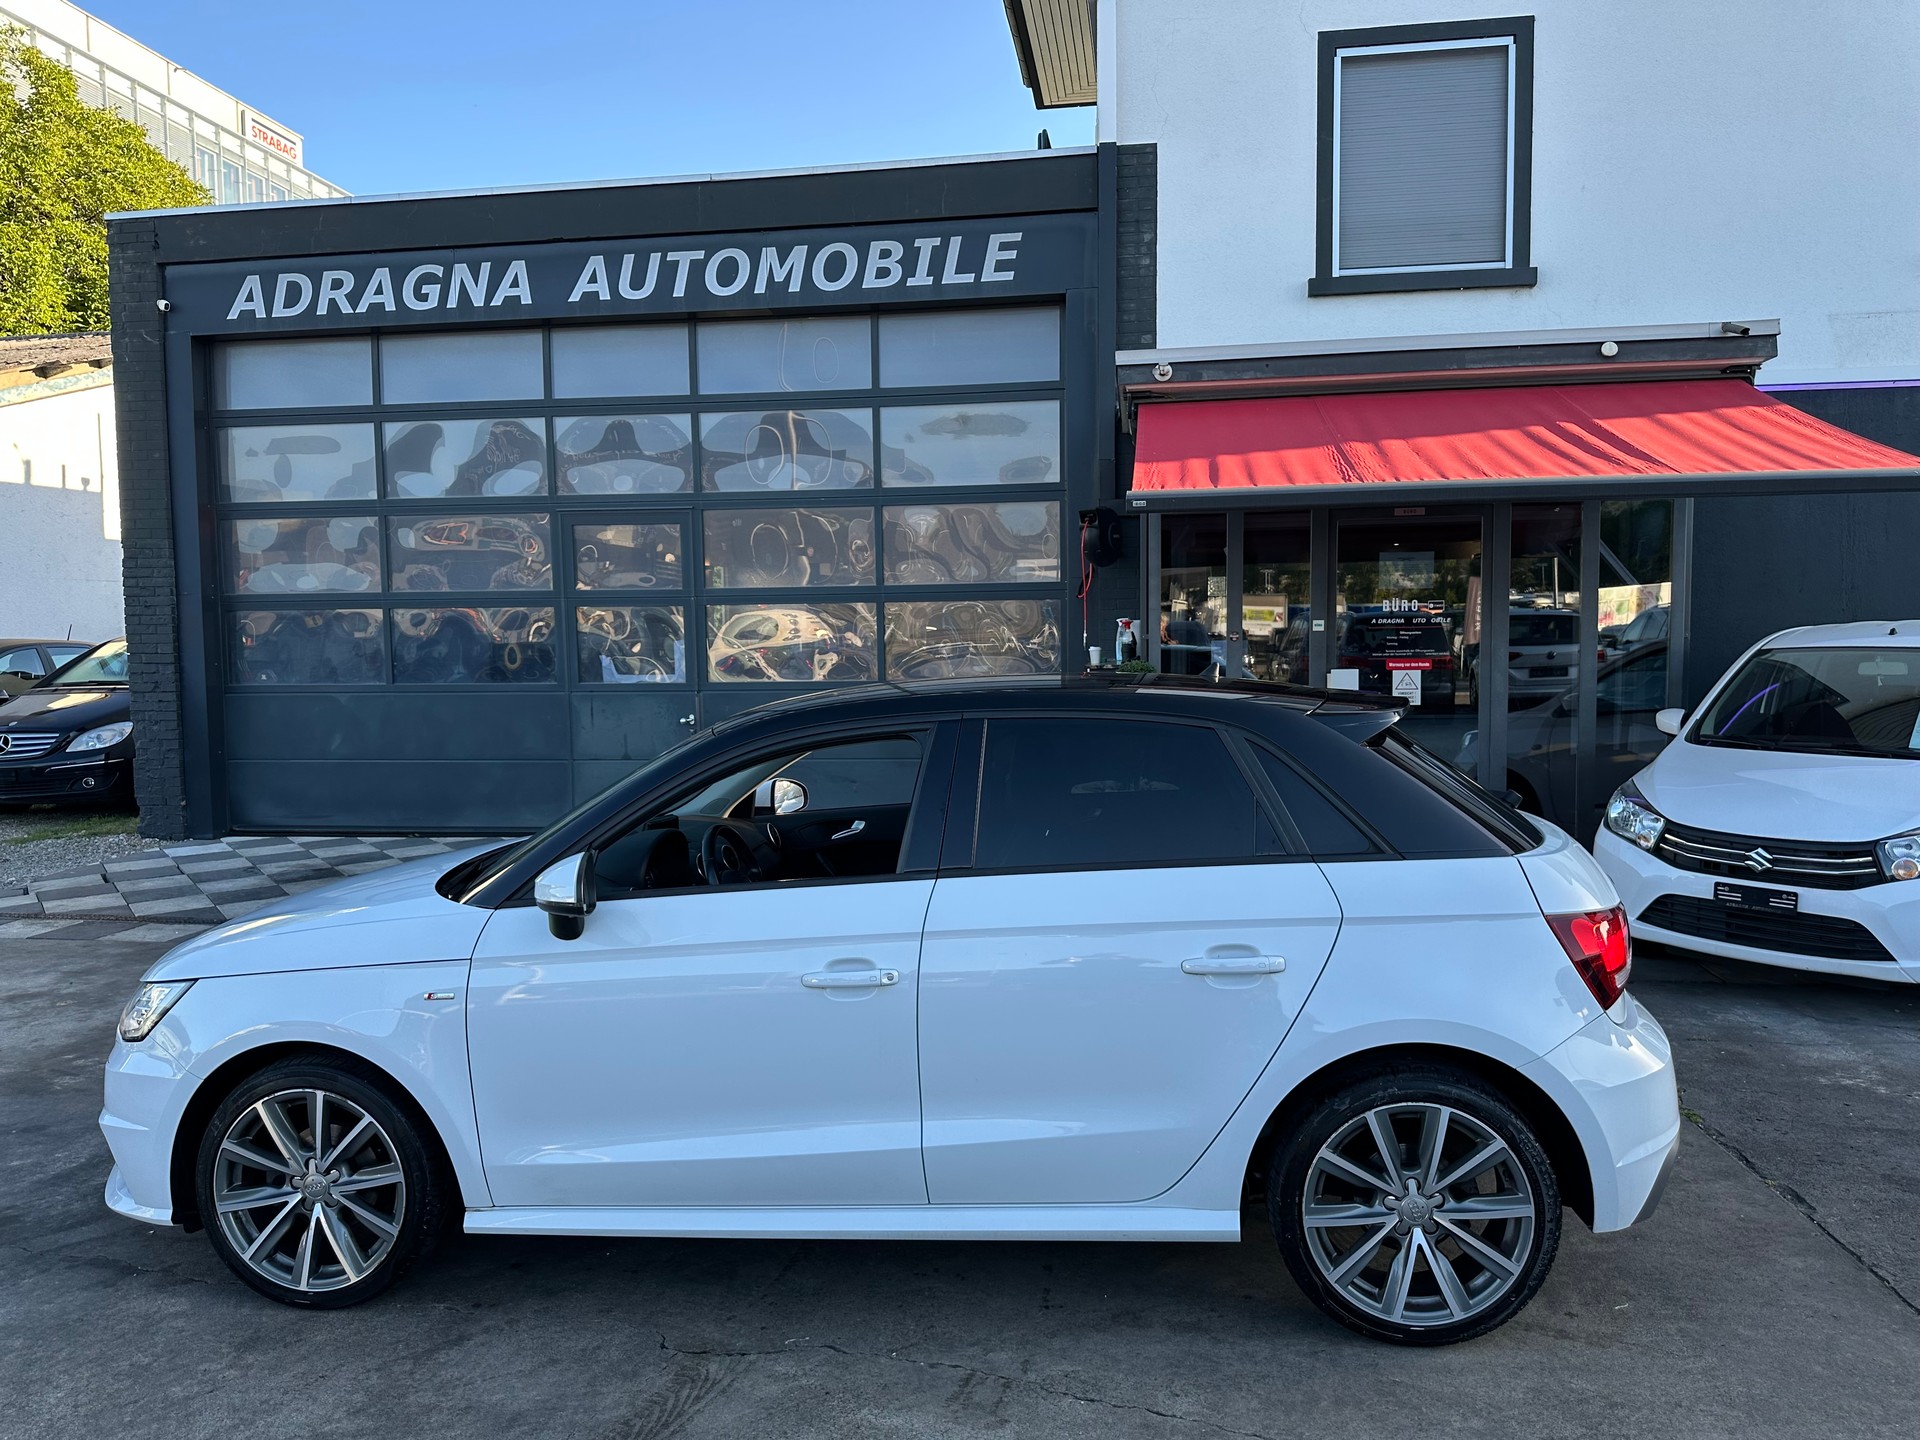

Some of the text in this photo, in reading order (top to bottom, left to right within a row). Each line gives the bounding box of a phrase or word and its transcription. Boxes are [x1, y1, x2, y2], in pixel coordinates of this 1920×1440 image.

[251, 125, 297, 160] STRABAG
[226, 231, 1024, 321] ADRAGNA AUTOMOBILE
[1382, 598, 1418, 612] BÜRO
